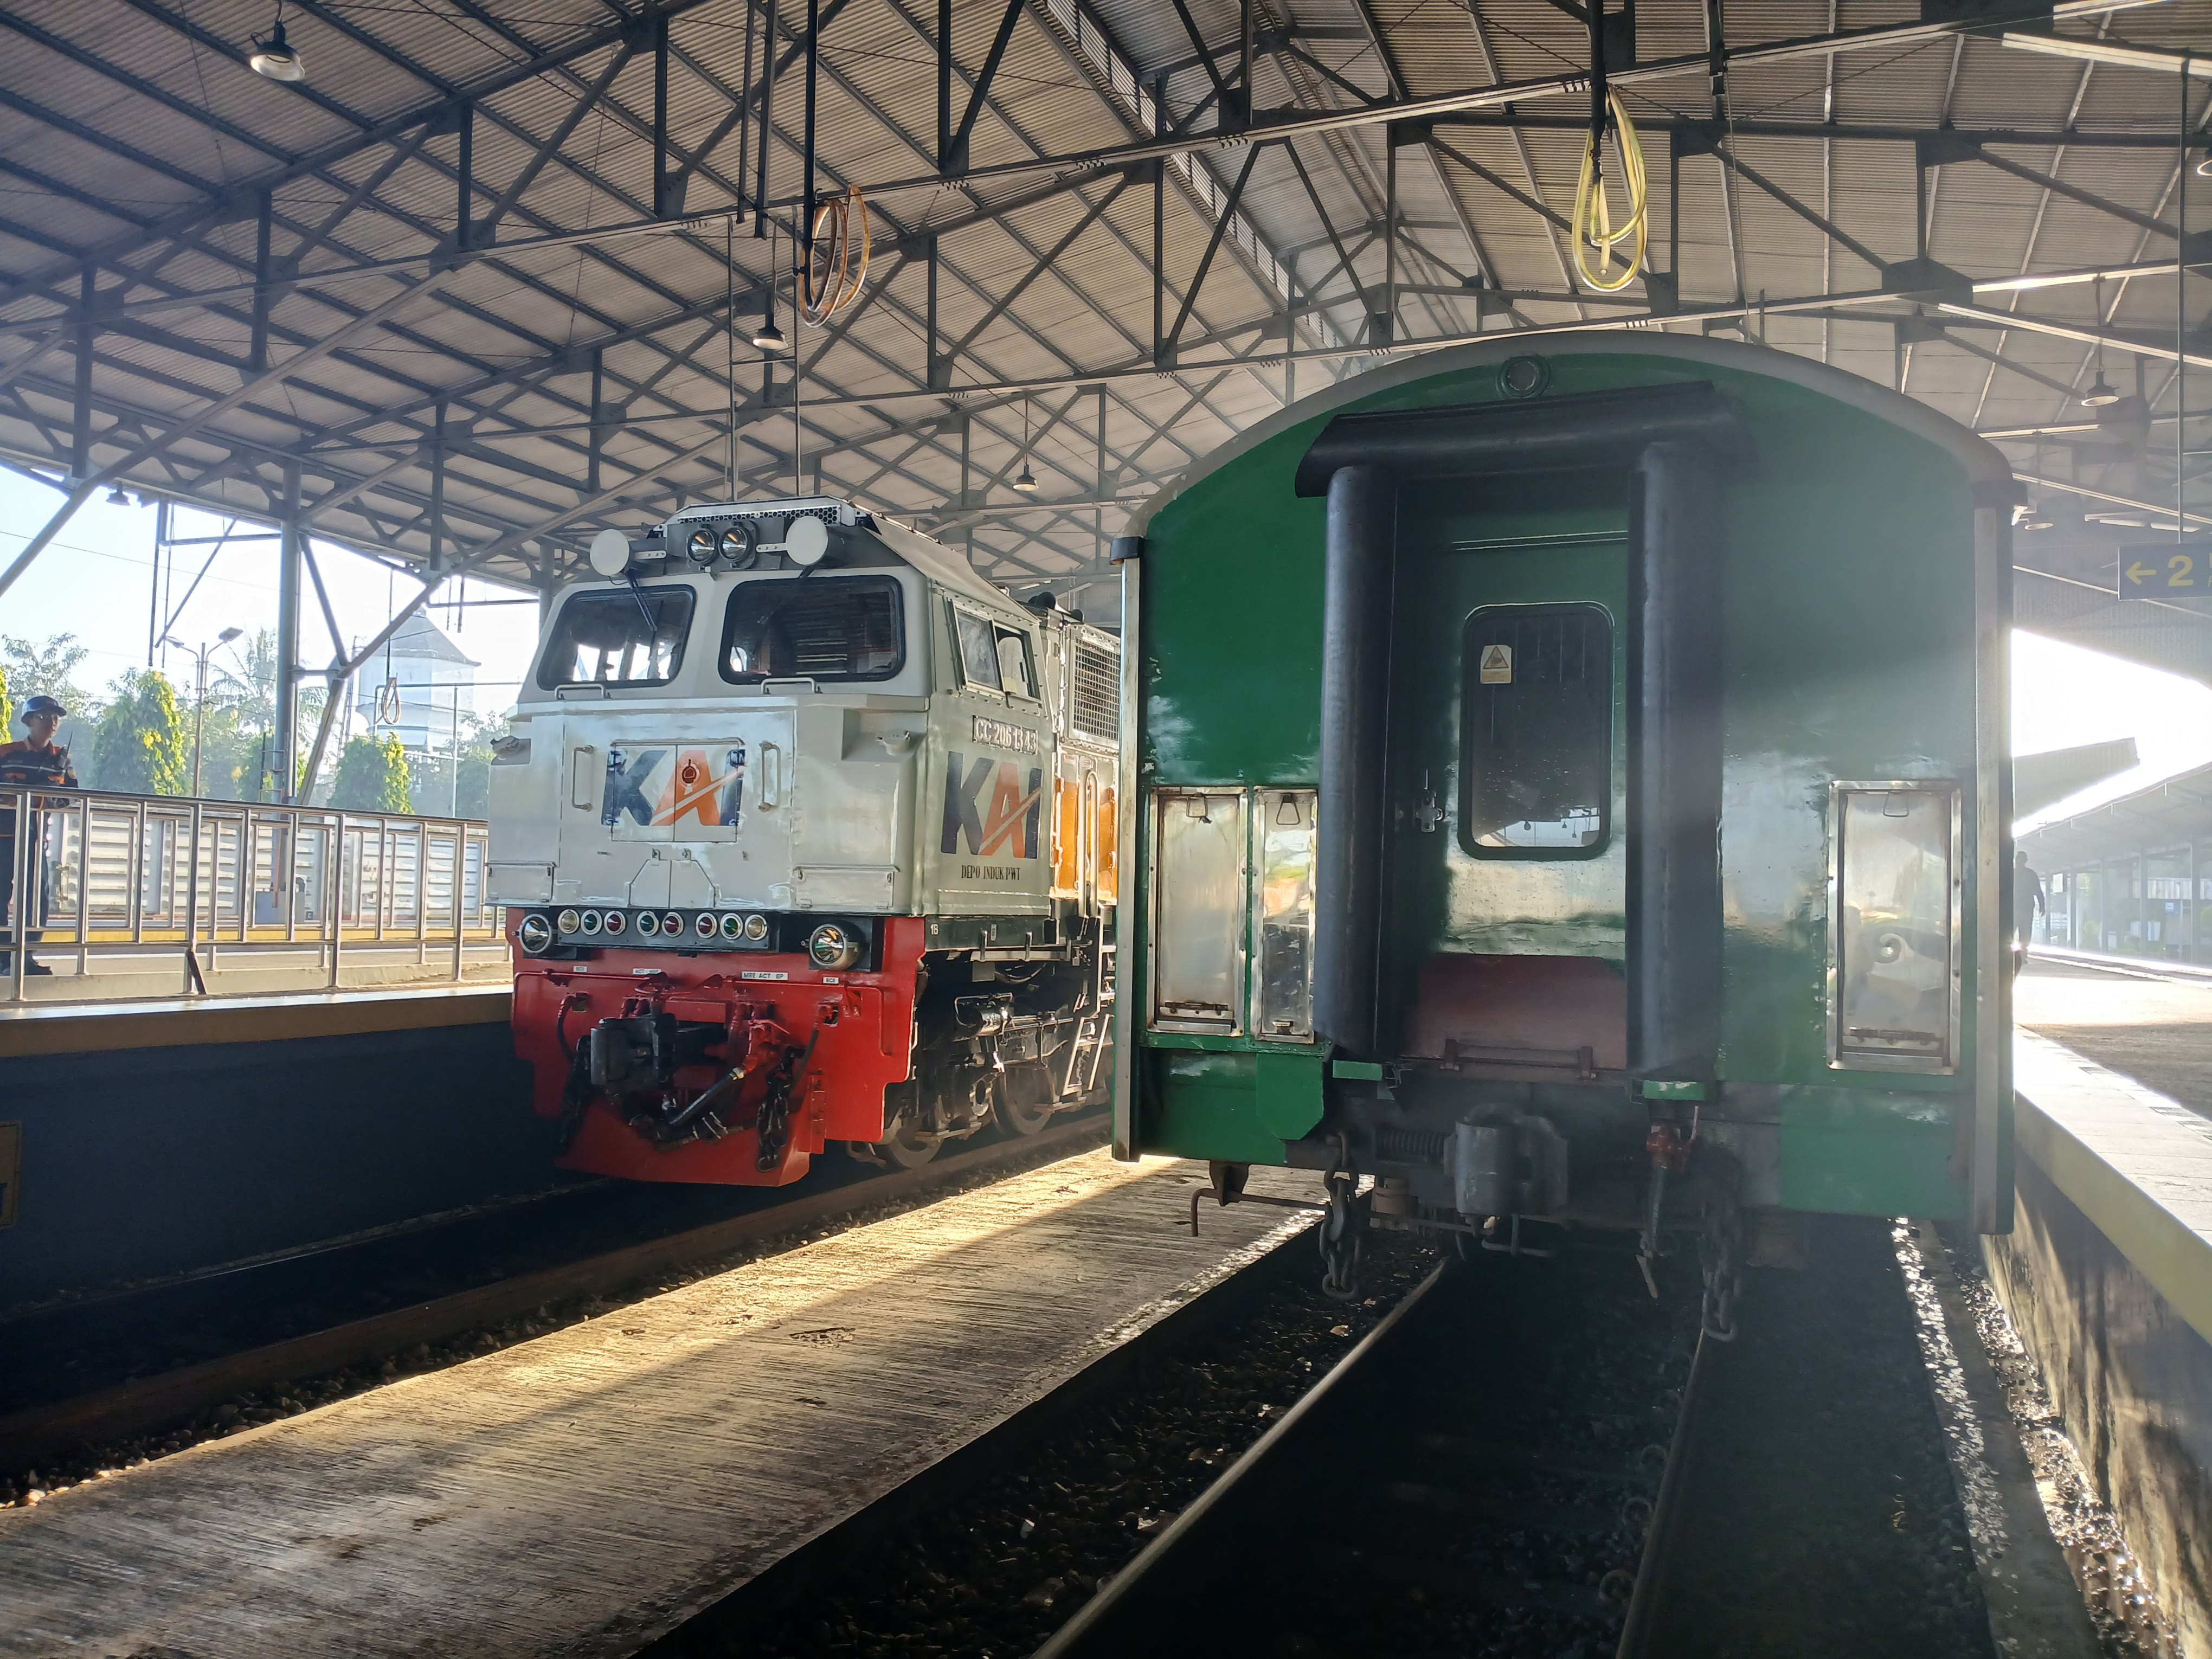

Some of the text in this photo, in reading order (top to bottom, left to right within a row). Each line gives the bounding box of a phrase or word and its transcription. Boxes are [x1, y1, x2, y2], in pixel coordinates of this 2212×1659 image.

[2168, 555, 2194, 586] 2
[976, 719, 992, 742] CC
[993, 723, 1012, 747] 206
[1025, 731, 1036, 751] 43
[601, 749, 746, 826] KAI
[941, 751, 1041, 859] KAI
[961, 865, 1020, 880] DEPO INDUK PWT
[930, 923, 938, 935] 1B
